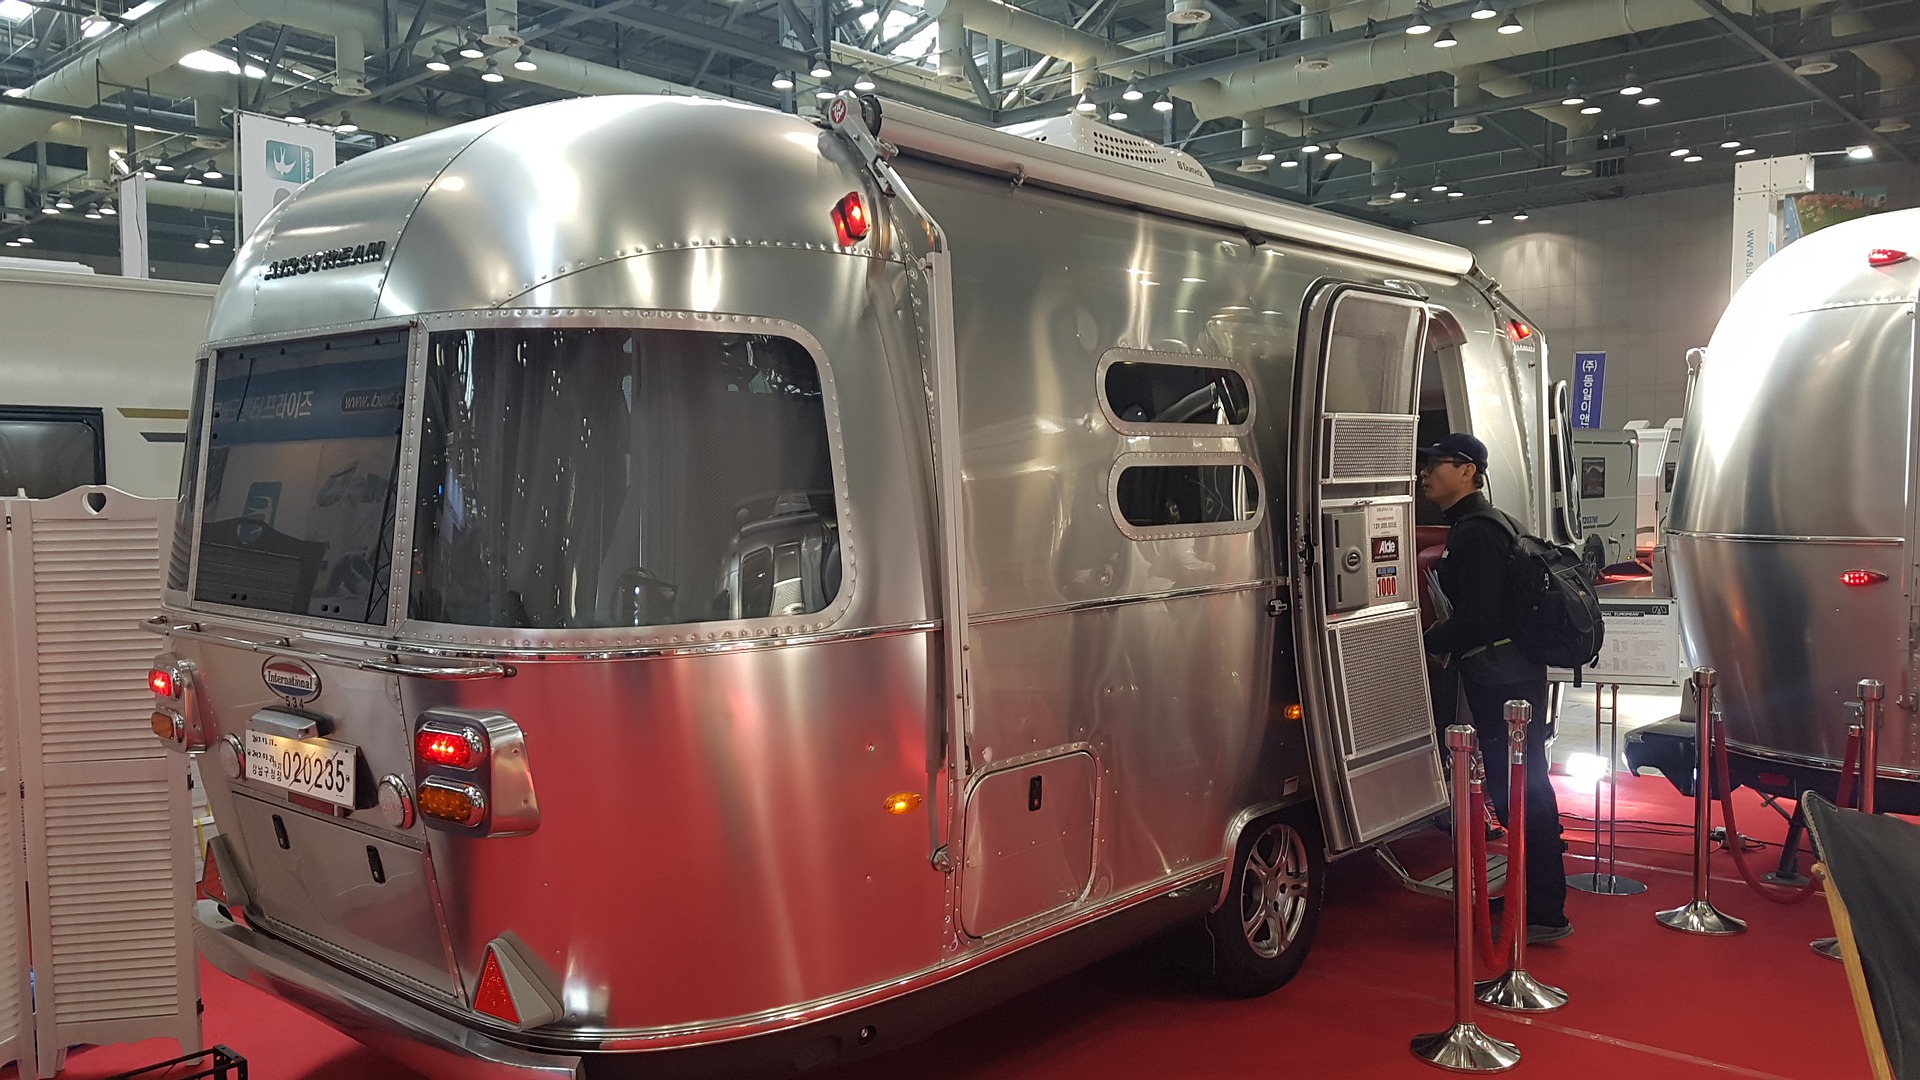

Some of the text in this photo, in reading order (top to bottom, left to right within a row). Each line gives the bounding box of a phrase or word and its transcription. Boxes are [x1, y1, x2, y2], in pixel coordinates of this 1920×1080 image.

[264, 241, 386, 280] AIRSTREAM
[1379, 540, 1396, 554] Alde
[1378, 577, 1396, 596] 1000
[268, 671, 313, 689] International
[285, 696, 304, 709] 534
[283, 751, 345, 792] 020235
